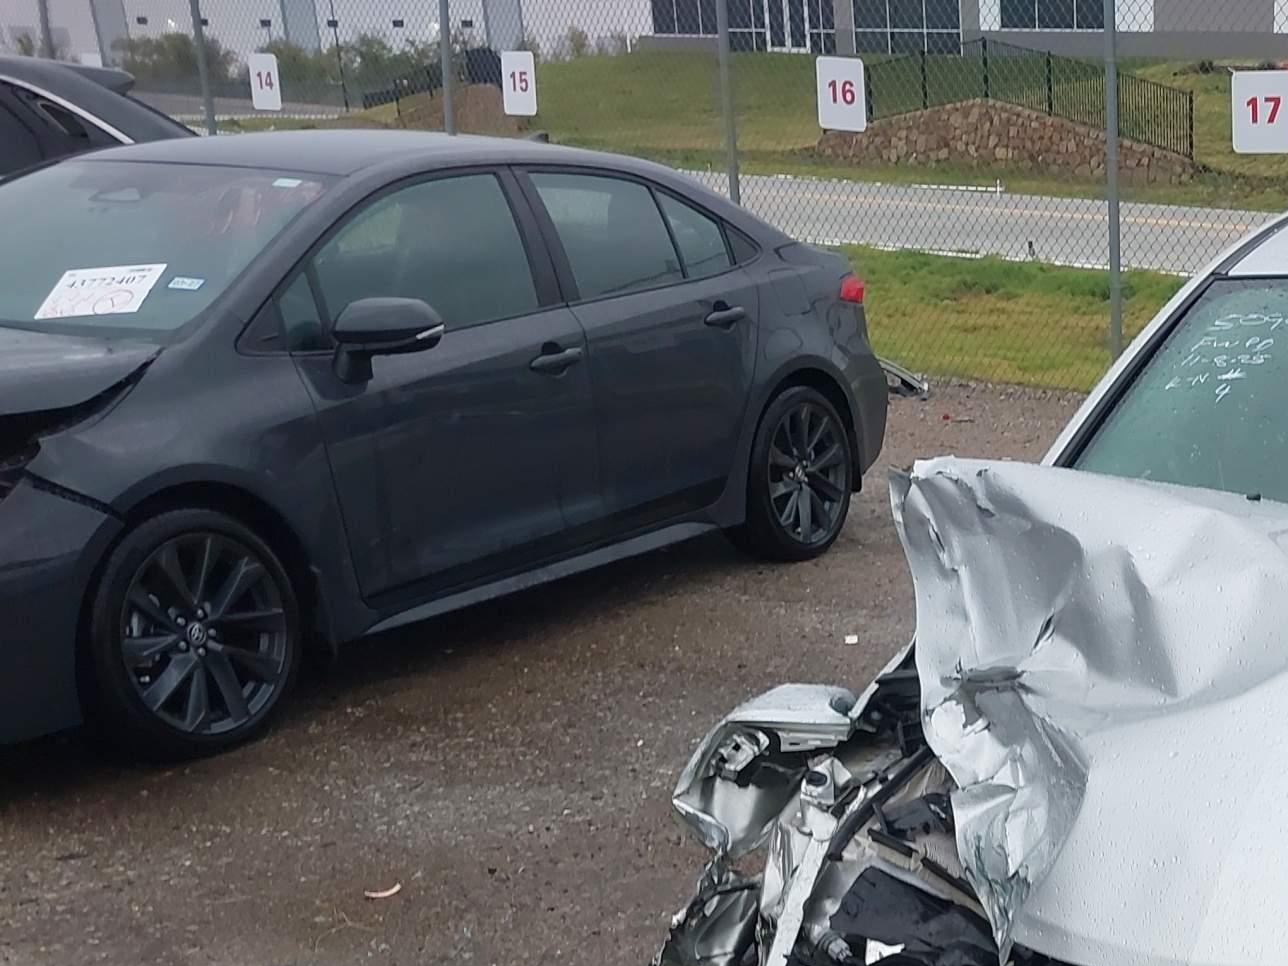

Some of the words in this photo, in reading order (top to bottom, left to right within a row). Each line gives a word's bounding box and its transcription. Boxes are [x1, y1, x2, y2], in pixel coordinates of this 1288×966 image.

[256, 71, 274, 91] 14
[509, 71, 529, 93] 15
[828, 79, 856, 105] 16
[1246, 96, 1281, 124] 17
